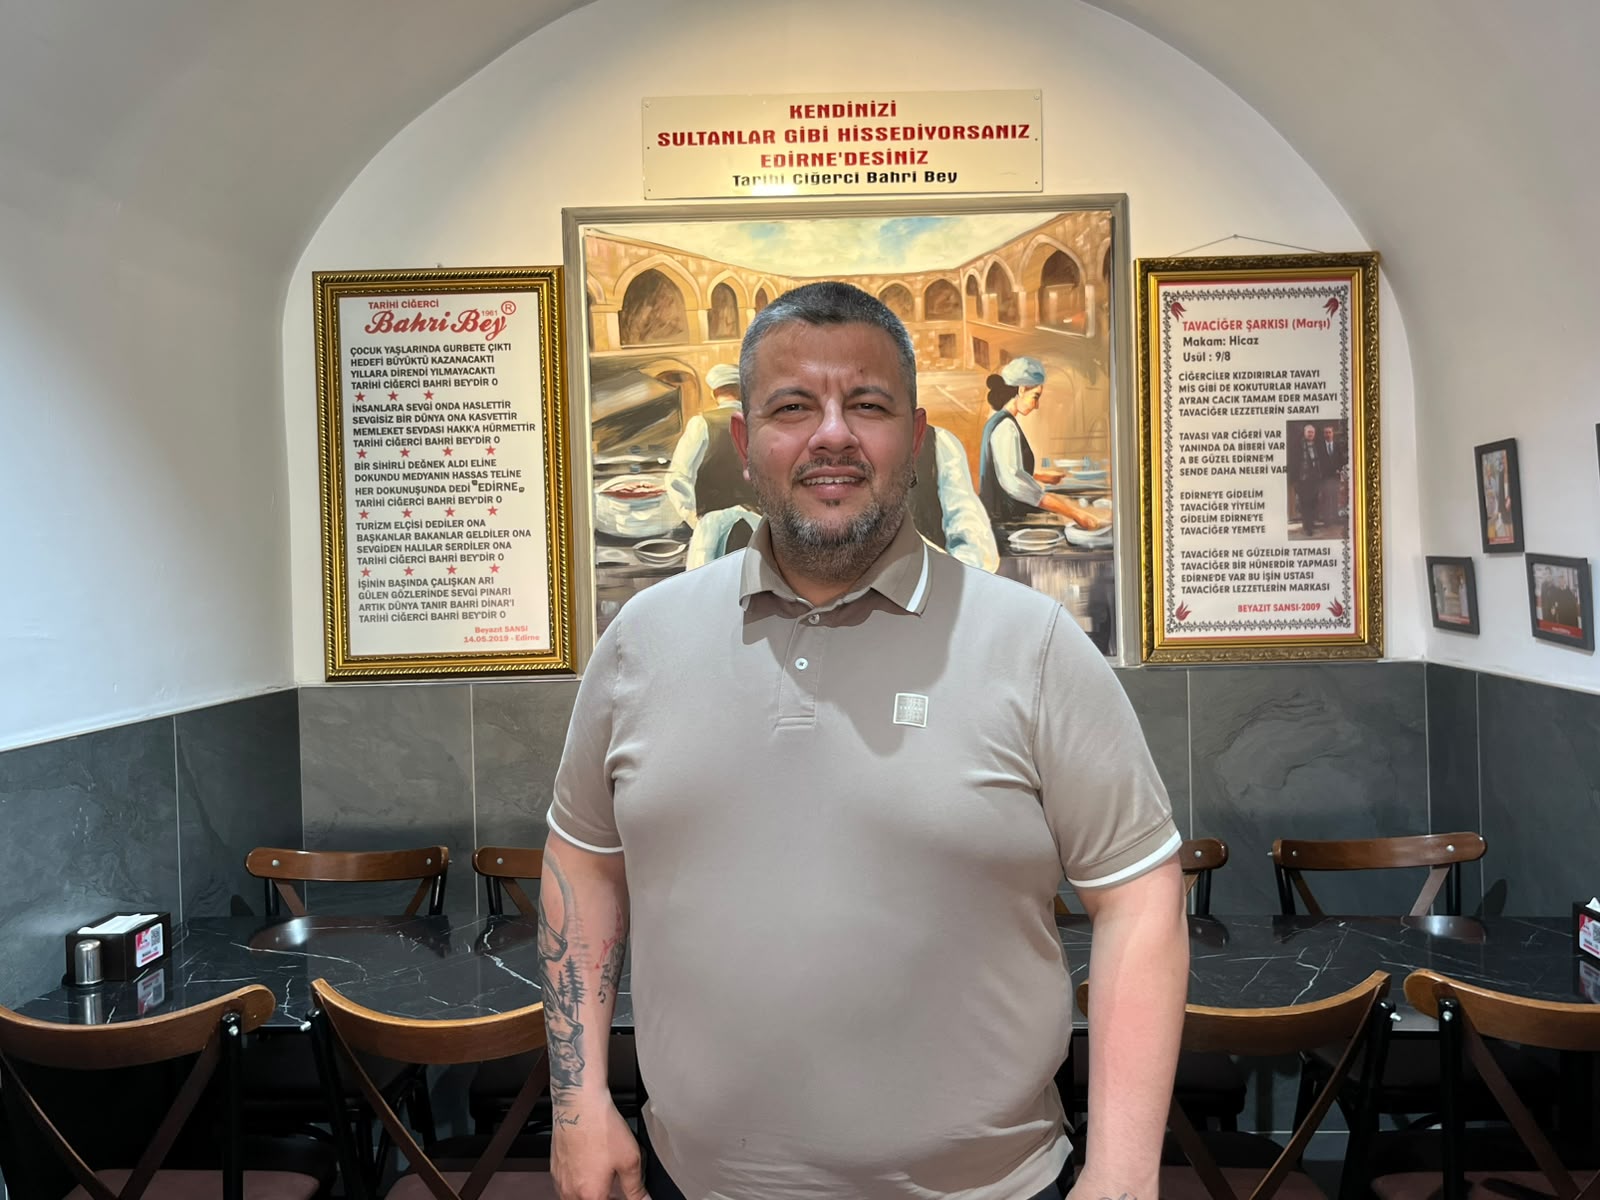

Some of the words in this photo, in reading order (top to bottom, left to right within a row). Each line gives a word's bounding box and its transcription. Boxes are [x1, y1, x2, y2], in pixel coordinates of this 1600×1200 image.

[790, 98, 896, 119] KENDİNİZİ
[658, 129, 775, 146] SULTANLAR
[785, 124, 828, 143] GİBİ
[838, 120, 1030, 142] HİSSEDİYORSANIZ
[761, 146, 928, 168] EDİRNE'DESİNİZ
[793, 172, 859, 188] Ciğerci
[867, 171, 916, 185] Bahri
[924, 170, 957, 186] Bey
[368, 299, 399, 310] TARİHİ
[401, 298, 439, 309] CİĞERCİ
[365, 310, 450, 334] Bahri
[450, 309, 507, 341] Bey
[1183, 318, 1243, 331] TAVACİĞER
[1246, 320, 1288, 332] ŞARKISI
[1292, 320, 1330, 330] (Marşı)
[1183, 337, 1226, 347] Makam:
[1230, 336, 1259, 346] Hicaz
[350, 346, 382, 357] ÇOCUK
[384, 345, 441, 356] YAŞLARINDA
[443, 344, 486, 353] GURBETE
[488, 343, 511, 353] ÇIKTI
[1183, 350, 1206, 362] Usül
[1215, 352, 1231, 362] 9/8
[351, 356, 384, 366] HEDEFİ
[431, 355, 494, 364] KAZANACAKTI
[350, 369, 389, 378] YILLARA
[390, 366, 428, 377] DİRENDİ
[430, 367, 495, 376] YILMAYACAKTI
[1179, 370, 1230, 381] CİĞERCİLER
[1233, 371, 1288, 380] KIZDIRIRLAR
[1290, 370, 1320, 378] TAVAYI
[351, 379, 381, 390] TARİHİ
[383, 378, 421, 389] CİĞERCİ
[423, 377, 452, 388] BAHRİ
[1179, 382, 1196, 392] MİS
[1198, 382, 1217, 392] GİBİ
[1219, 384, 1231, 392] DE
[1233, 383, 1292, 391] KOKUTURLAR
[1294, 382, 1326, 390] HAVAYI
[353, 401, 404, 412] İNSANLARA
[406, 401, 432, 411] SEVGİ
[435, 402, 460, 410] ONDA
[463, 399, 511, 410] HASLETTİR
[1179, 396, 1209, 405] AYRAN
[1213, 396, 1239, 404] CACIK
[1243, 395, 1275, 403] TAMAM
[1304, 394, 1338, 402] MASAYI
[353, 413, 394, 424] SEVGİSİZ
[396, 413, 412, 423] BİR
[447, 414, 467, 422] ONA
[469, 410, 517, 422] KASVETTİR
[1179, 406, 1228, 417] TAVACİĞER
[1230, 405, 1285, 415] LEZZETLERİN
[1287, 406, 1319, 414] SARAYI
[353, 427, 404, 436] MEMLEKET
[406, 426, 444, 434] SEVDASI
[1179, 432, 1209, 440] TAVASI
[1211, 432, 1229, 440] VAR
[1231, 429, 1262, 439] CİĞERİ
[1264, 430, 1282, 438] VAR
[1179, 444, 1220, 452] YANINDA
[1238, 441, 1265, 451] BİBERİ
[1268, 442, 1285, 450] VAR
[354, 460, 370, 471] BİR
[373, 459, 406, 470] SİHİRLİ
[408, 458, 445, 469] DEĞNEK
[448, 460, 468, 468] ALDI
[471, 457, 496, 468] ELİNE
[1180, 468, 1209, 476] SENDE
[1211, 467, 1237, 475] DAHA
[1239, 464, 1269, 474] NELERİ
[355, 473, 399, 482] DOKUNDU
[403, 472, 449, 481] MEDYANIN
[453, 471, 488, 480] HASSAS
[491, 468, 522, 479] TELİNE
[355, 487, 374, 495] HER
[377, 485, 446, 496] DOKUNUŞUNDA
[449, 483, 470, 493] DEDİ
[1226, 488, 1263, 498] GİDELİM
[1180, 501, 1228, 511] TAVACİĞER
[1232, 500, 1265, 510] YİYELİM
[1180, 513, 1218, 523] GİDELİM
[356, 520, 392, 530] TURİZM
[394, 519, 423, 531] ELÇİSİ
[425, 518, 464, 529] DEDİLER
[467, 519, 486, 528] ONA
[1180, 524, 1230, 535] TAVACİĞER
[1231, 526, 1265, 534] YEMEYE
[357, 533, 412, 544] BAŞKANLAR
[414, 531, 464, 540] BAKANLAR
[466, 528, 510, 539] GELDİLER
[512, 530, 531, 538] ONA
[357, 542, 402, 553] SEVGİDEN
[404, 543, 443, 552] HALILAR
[445, 540, 490, 551] SERDİLER
[492, 542, 512, 550] ONA
[1181, 548, 1230, 559] TAVACİĞER
[1232, 550, 1244, 558] NE
[1292, 549, 1330, 557] TATMASI
[1181, 560, 1230, 570] TAVACİĞER
[1232, 559, 1247, 569] BİR
[1297, 560, 1337, 568] YAPMASI
[1228, 573, 1246, 581] VAR
[1248, 573, 1261, 581] BU
[1263, 571, 1281, 582] İŞİN
[1283, 572, 1314, 580] USTASI
[358, 577, 386, 590] İŞİNİN
[388, 578, 429, 589] BAŞINDA
[430, 577, 476, 588] ÇALIŞKAN
[478, 577, 494, 585] ARI
[1181, 583, 1230, 594] TAVACİĞER
[1233, 583, 1287, 593] LEZZETLERİN
[1289, 584, 1330, 592] MARKASI
[391, 587, 449, 598] GÖZLERİNDE
[451, 587, 478, 597] SEVGİ
[480, 588, 511, 597] PINARI
[359, 603, 386, 611] ARTIK
[420, 601, 448, 610] TANIR
[450, 598, 479, 609] BAHRİ
[1238, 604, 1271, 612] BEYAZIT
[1273, 603, 1320, 612] SANSI-2009
[358, 612, 389, 623] TARİHİ
[391, 611, 428, 622] CİĞERCİ
[430, 610, 459, 621] BAHRİ
